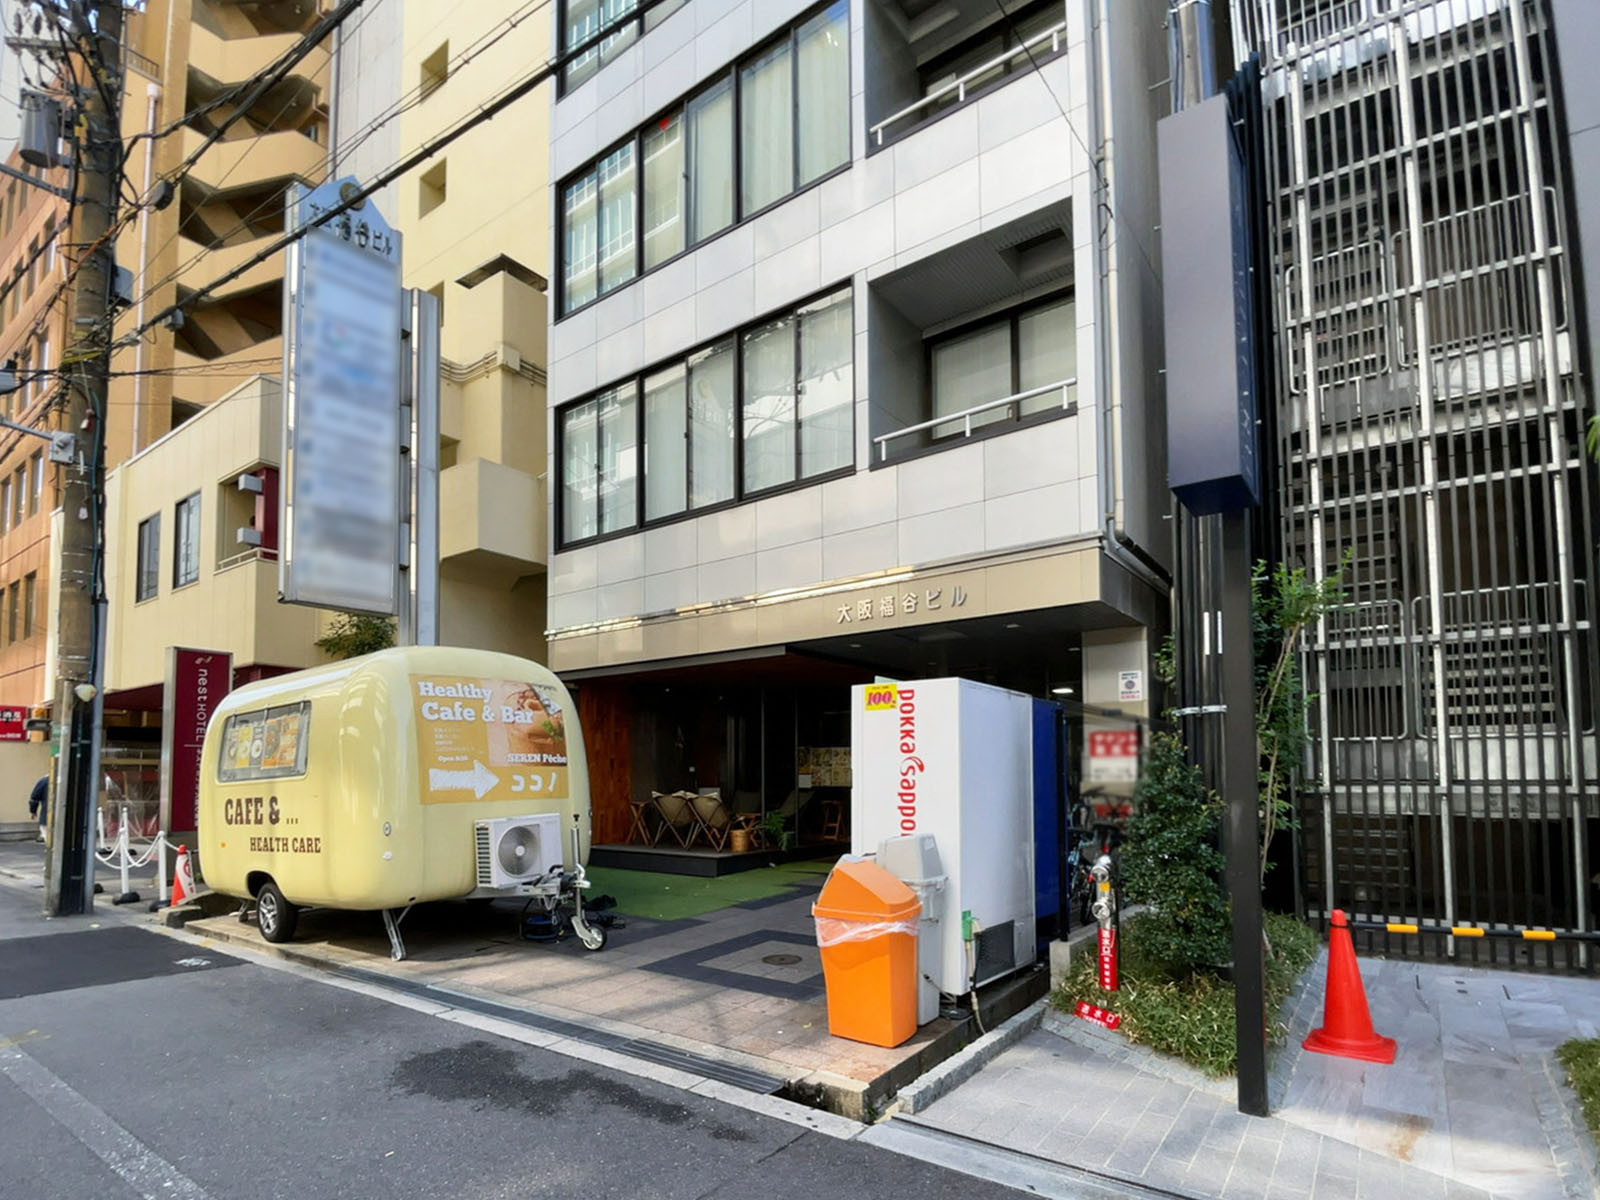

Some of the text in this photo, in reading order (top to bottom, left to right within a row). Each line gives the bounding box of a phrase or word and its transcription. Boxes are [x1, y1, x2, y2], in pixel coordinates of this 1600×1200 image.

[837, 586, 967, 623] 大阪福谷ビル
[417, 681, 492, 703] Healthy
[866, 691, 892, 706] 100
[421, 702, 534, 723] Cafe & Bar
[224, 798, 264, 825] CAFE
[269, 796, 280, 825] &
[897, 762, 916, 837] sappo
[250, 837, 321, 853] HEALTH CARE
